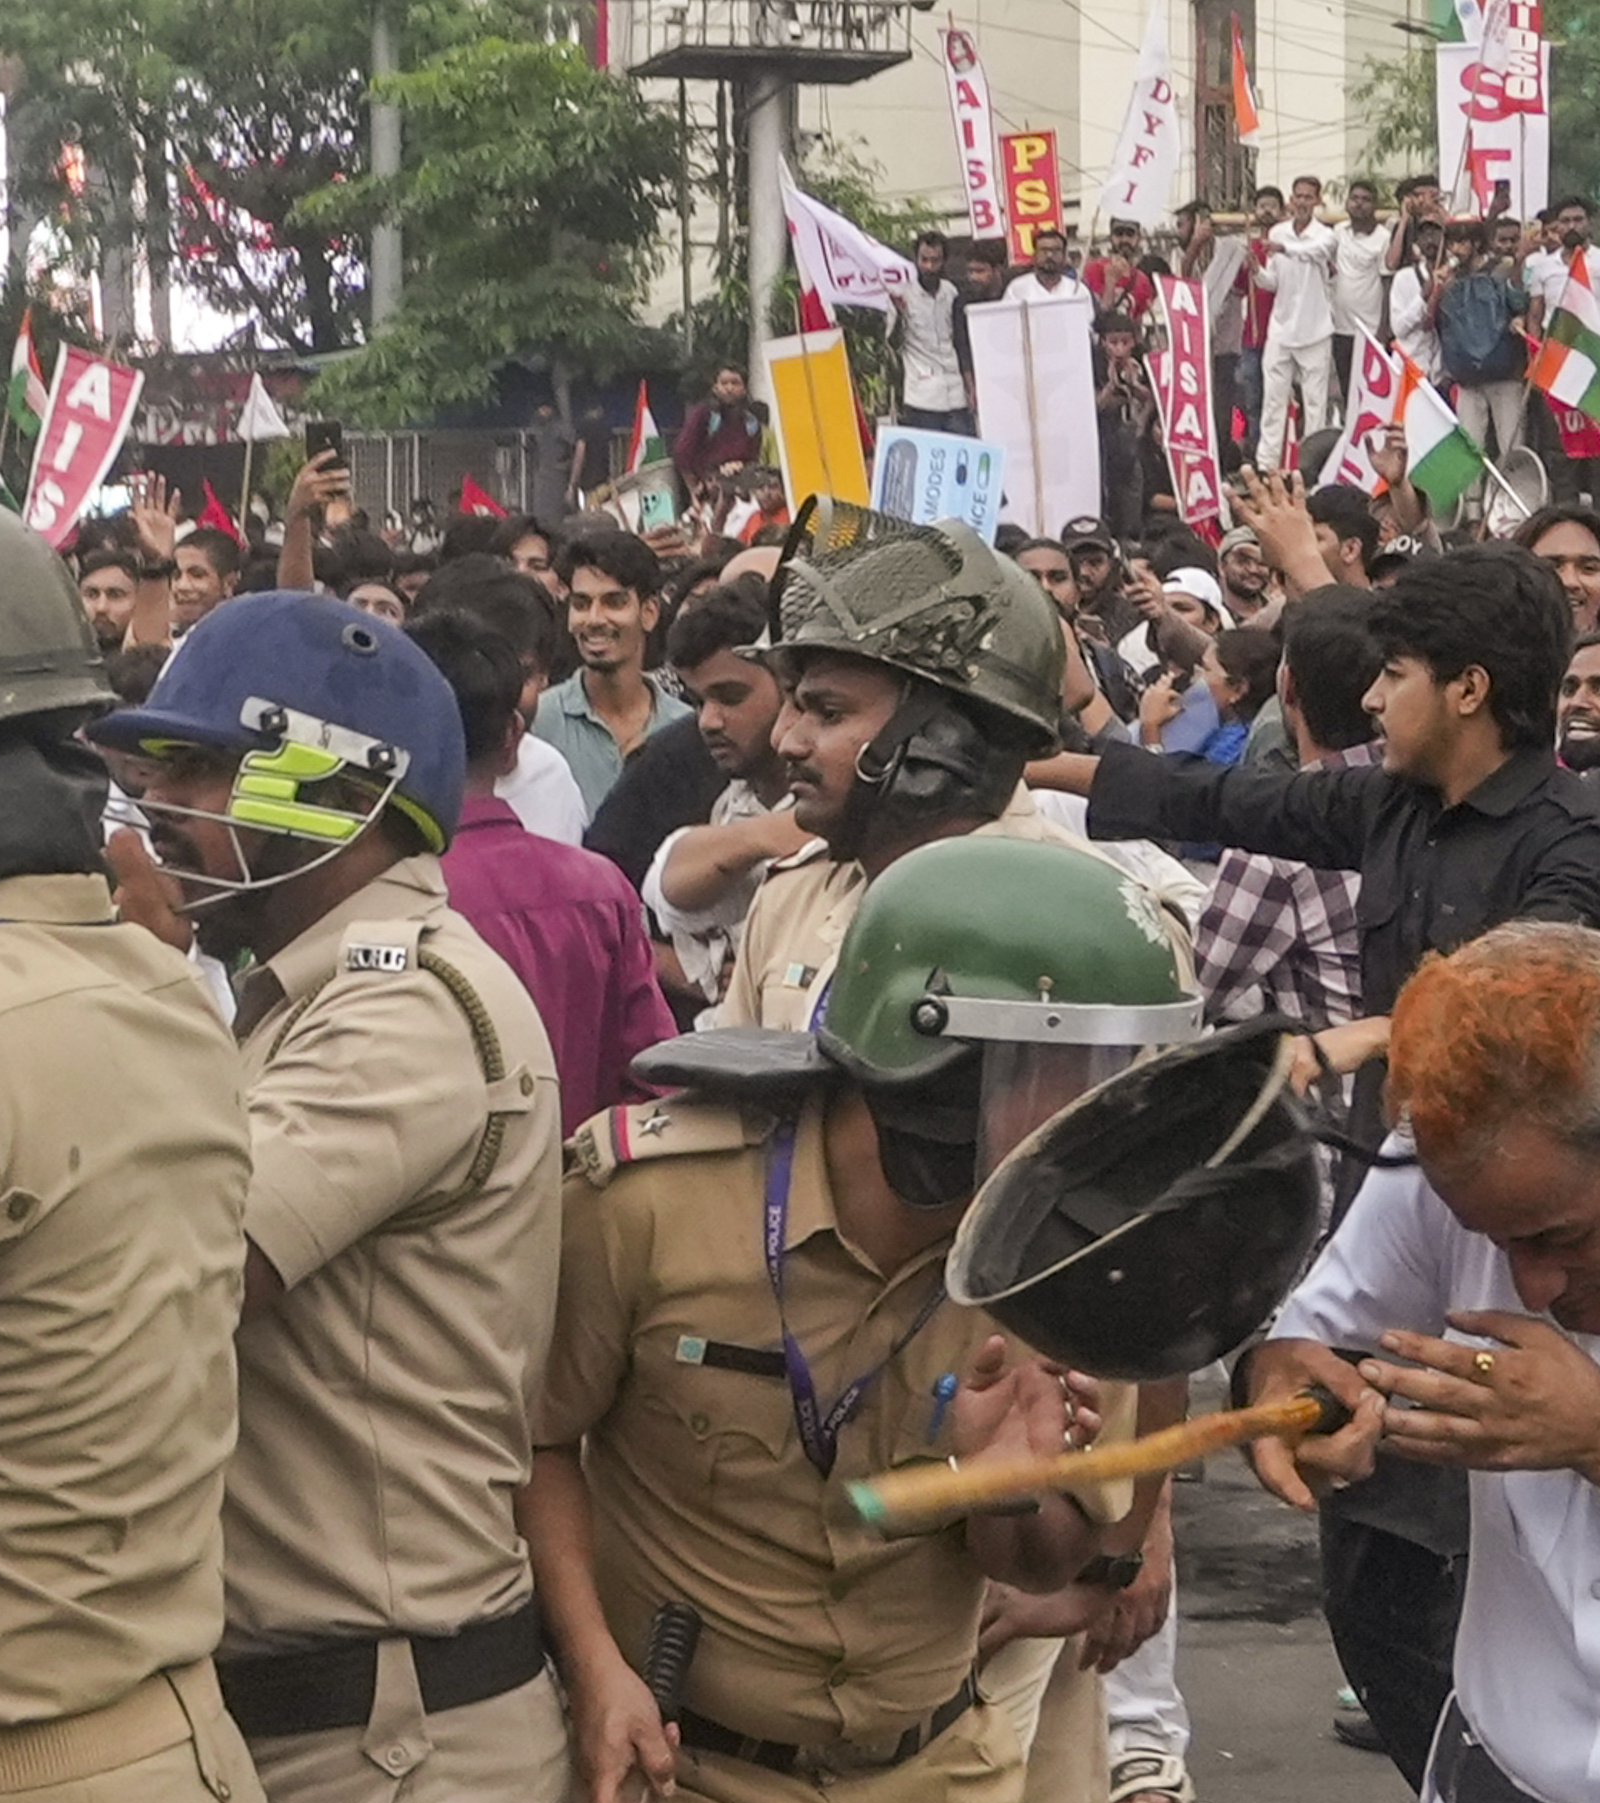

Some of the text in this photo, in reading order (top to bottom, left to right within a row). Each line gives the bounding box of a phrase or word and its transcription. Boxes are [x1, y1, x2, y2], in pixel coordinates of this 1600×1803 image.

[1507, 0, 1538, 99] IDSO
[956, 79, 995, 229] AISB
[1121, 77, 1172, 204] DYFI
[1170, 280, 1204, 440] AISA
